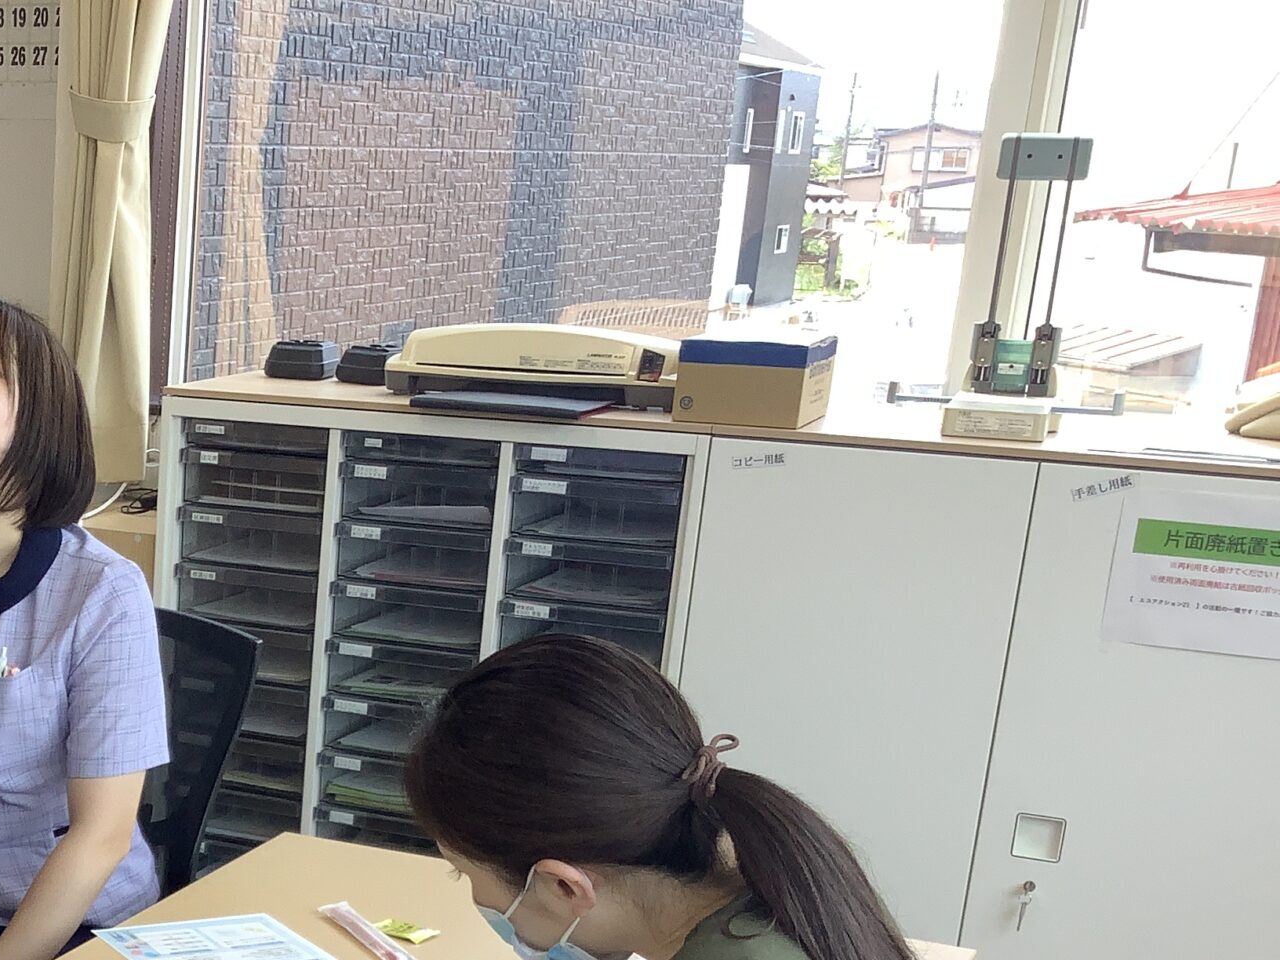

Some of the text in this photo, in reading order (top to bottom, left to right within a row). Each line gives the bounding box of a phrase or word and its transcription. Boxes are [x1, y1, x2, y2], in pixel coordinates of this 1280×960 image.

[12, 8, 26, 27] 19
[33, 8, 48, 27] 20
[11, 47, 25, 66] 26
[33, 46, 47, 66] 27
[734, 453, 785, 467] コピー用紙
[1074, 475, 1133, 500] 手差し用紙
